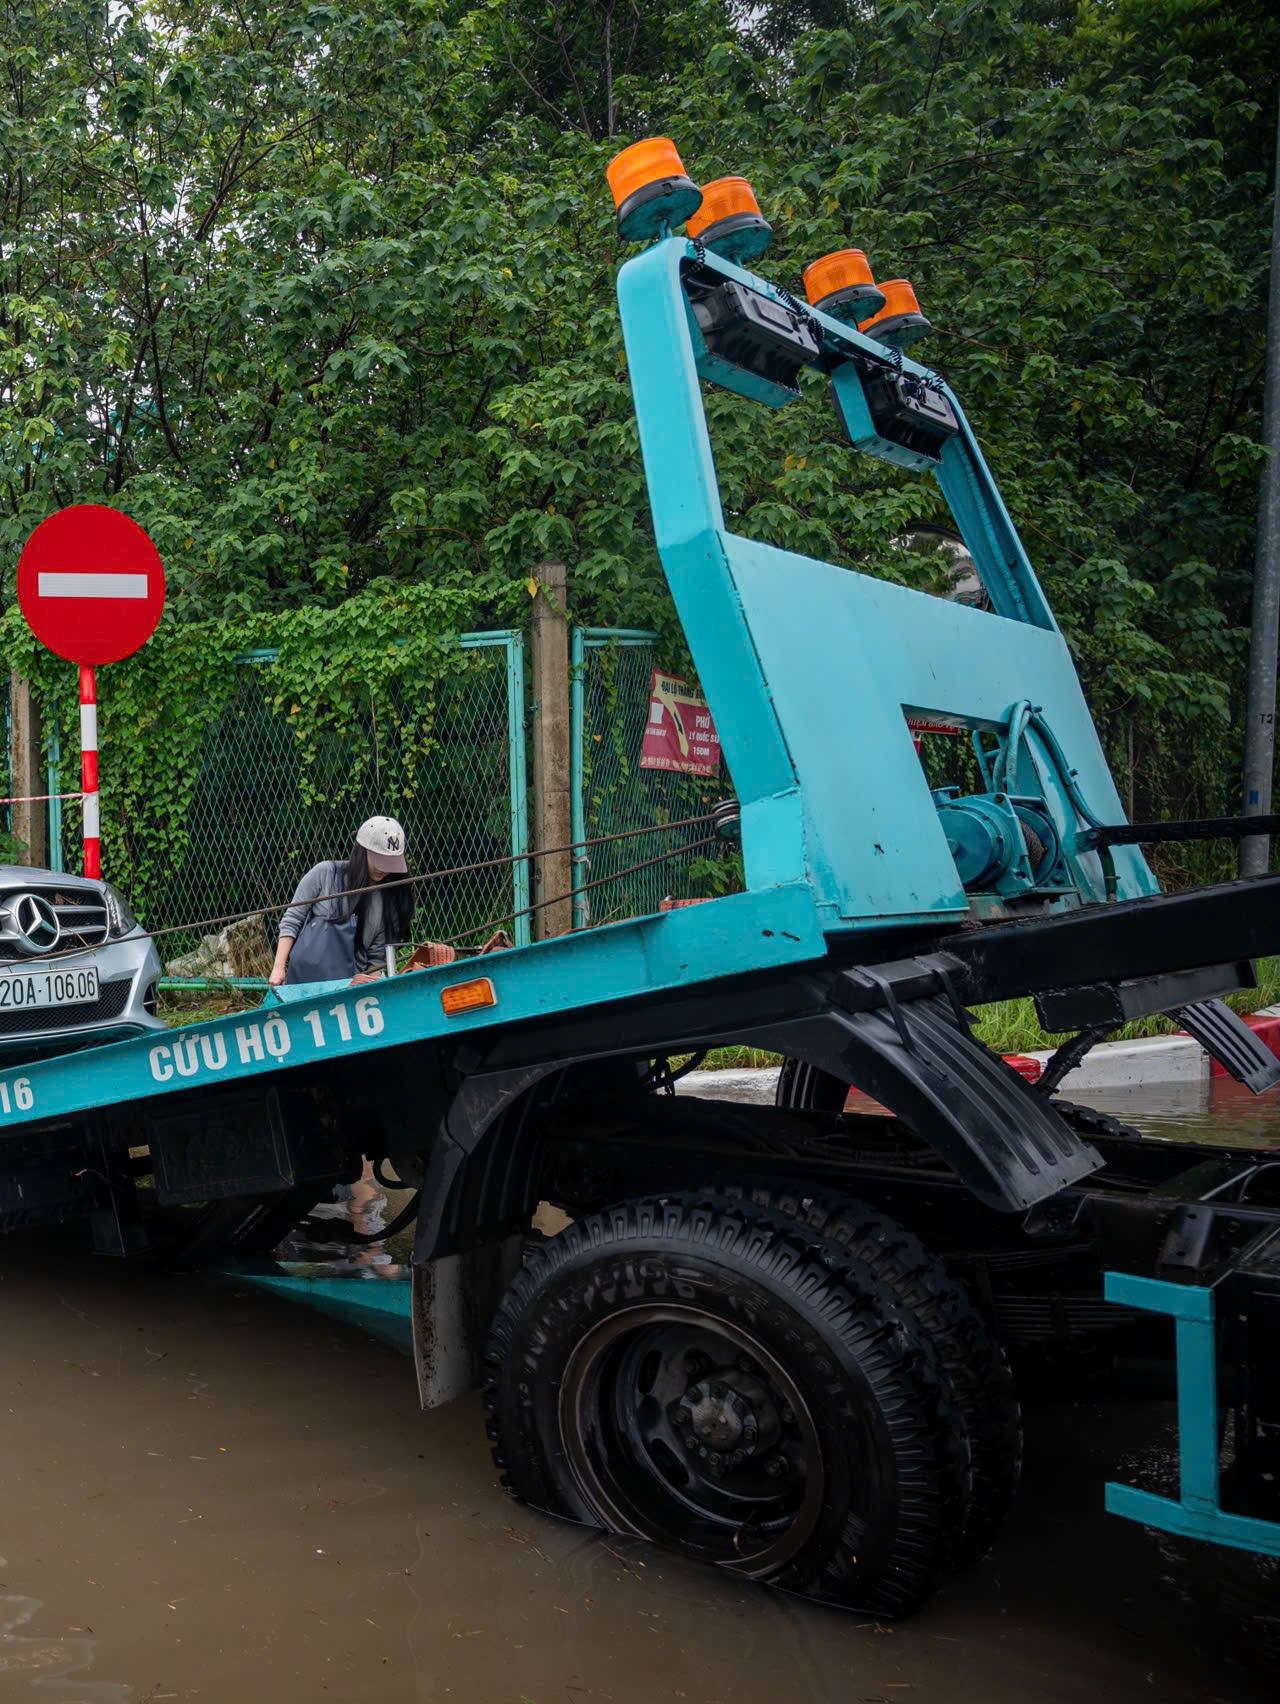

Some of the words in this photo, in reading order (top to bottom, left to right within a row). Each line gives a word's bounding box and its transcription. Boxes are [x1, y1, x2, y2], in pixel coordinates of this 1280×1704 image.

[149, 1032, 227, 1082] CỨU
[235, 1011, 291, 1062] HỘ
[303, 996, 385, 1047] 116
